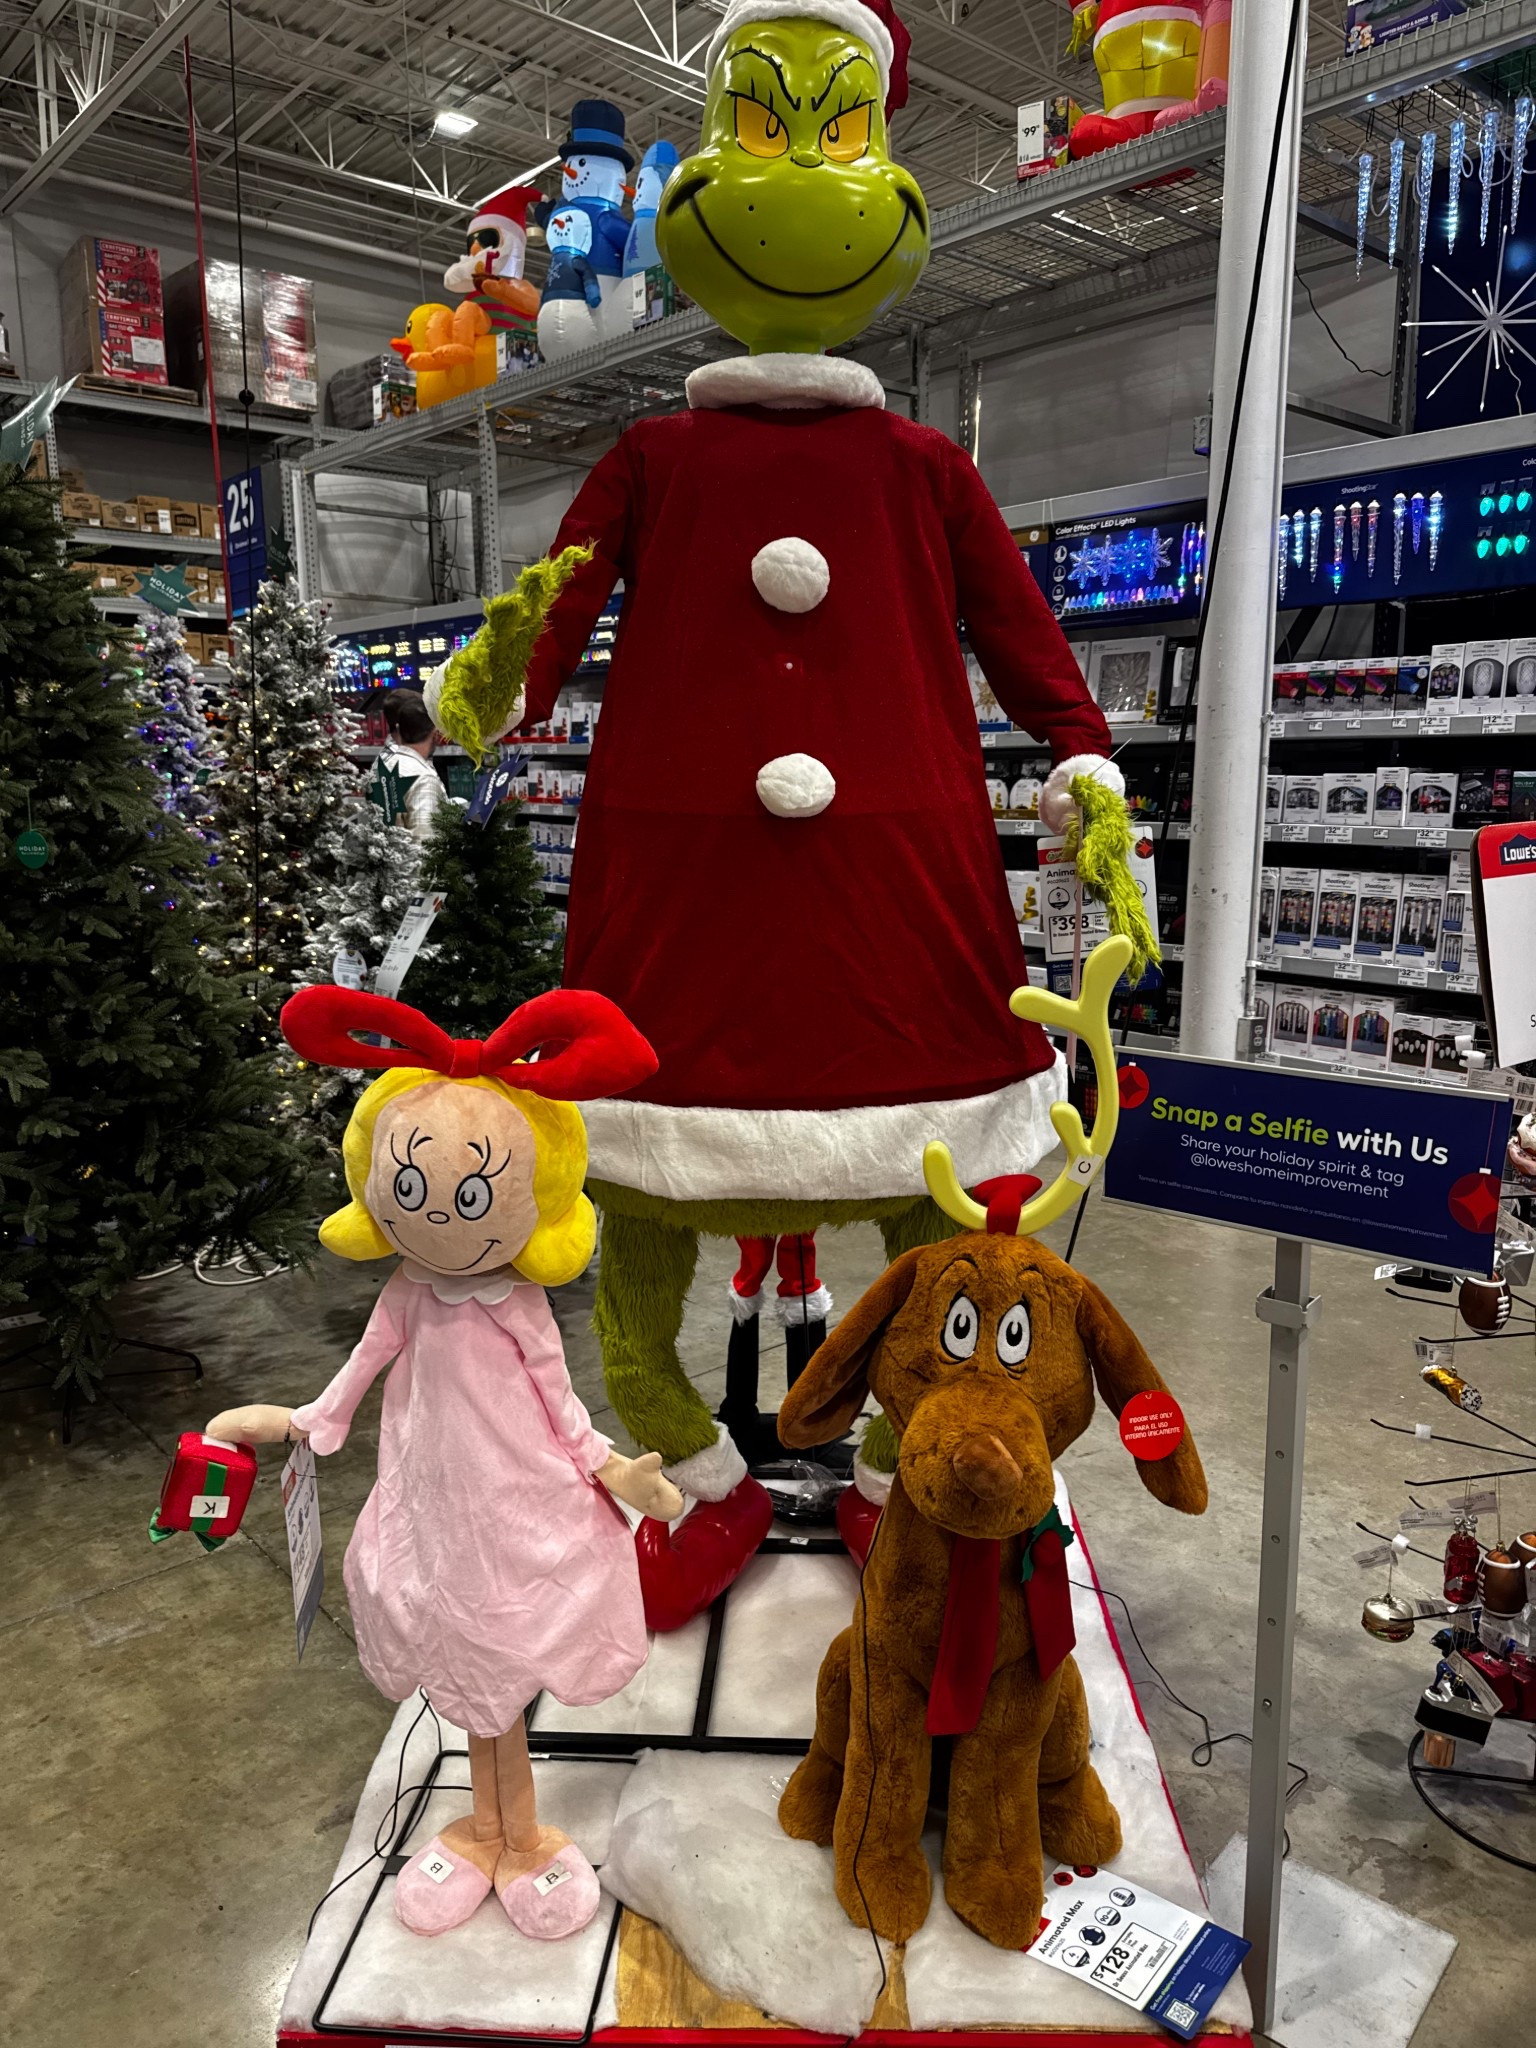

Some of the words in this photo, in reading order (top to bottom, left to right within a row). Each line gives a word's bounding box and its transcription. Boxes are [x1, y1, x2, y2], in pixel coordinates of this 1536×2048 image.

[106, 313, 138, 324] CRAFTSMAN
[227, 477, 254, 534] 25
[1055, 526, 1073, 535] Color
[1100, 520, 1114, 528] LED
[1114, 517, 1137, 528] Lights
[149, 576, 186, 600] HOLIDAY
[1046, 868, 1076, 879] Anima
[1151, 1097, 1219, 1132] Snap
[1224, 1114, 1243, 1132] a
[1249, 1112, 1329, 1146] Selfie
[1336, 1128, 1402, 1158] with
[1410, 1136, 1449, 1165] Us
[1180, 1134, 1221, 1152] Share
[1224, 1145, 1257, 1158] your
[1260, 1147, 1315, 1170] holiday
[1318, 1160, 1357, 1176] spirit
[1360, 1164, 1372, 1178] &
[1377, 1168, 1405, 1187] tag
[1190, 1153, 1390, 1199] @loweshomeimprovement
[1134, 1424, 1150, 1432] PARA
[1149, 1413, 1159, 1421] USE
[1159, 1411, 1173, 1419] ONLY
[203, 1501, 216, 1514] K
[430, 1862, 444, 1874] B
[1038, 1916, 1071, 1955] Animated
[1066, 1900, 1085, 1918] Max
[1094, 1947, 1130, 1979] $128
[1117, 1969, 1129, 1983] Seuss
[1127, 1953, 1142, 1971] Animated
[1149, 2002, 1157, 2011] Get
[1154, 1994, 1162, 2004] free
[1160, 1980, 1175, 1997] shipping
[1174, 1962, 1187, 1978] holiday
[1190, 1938, 1204, 1956] purchased
